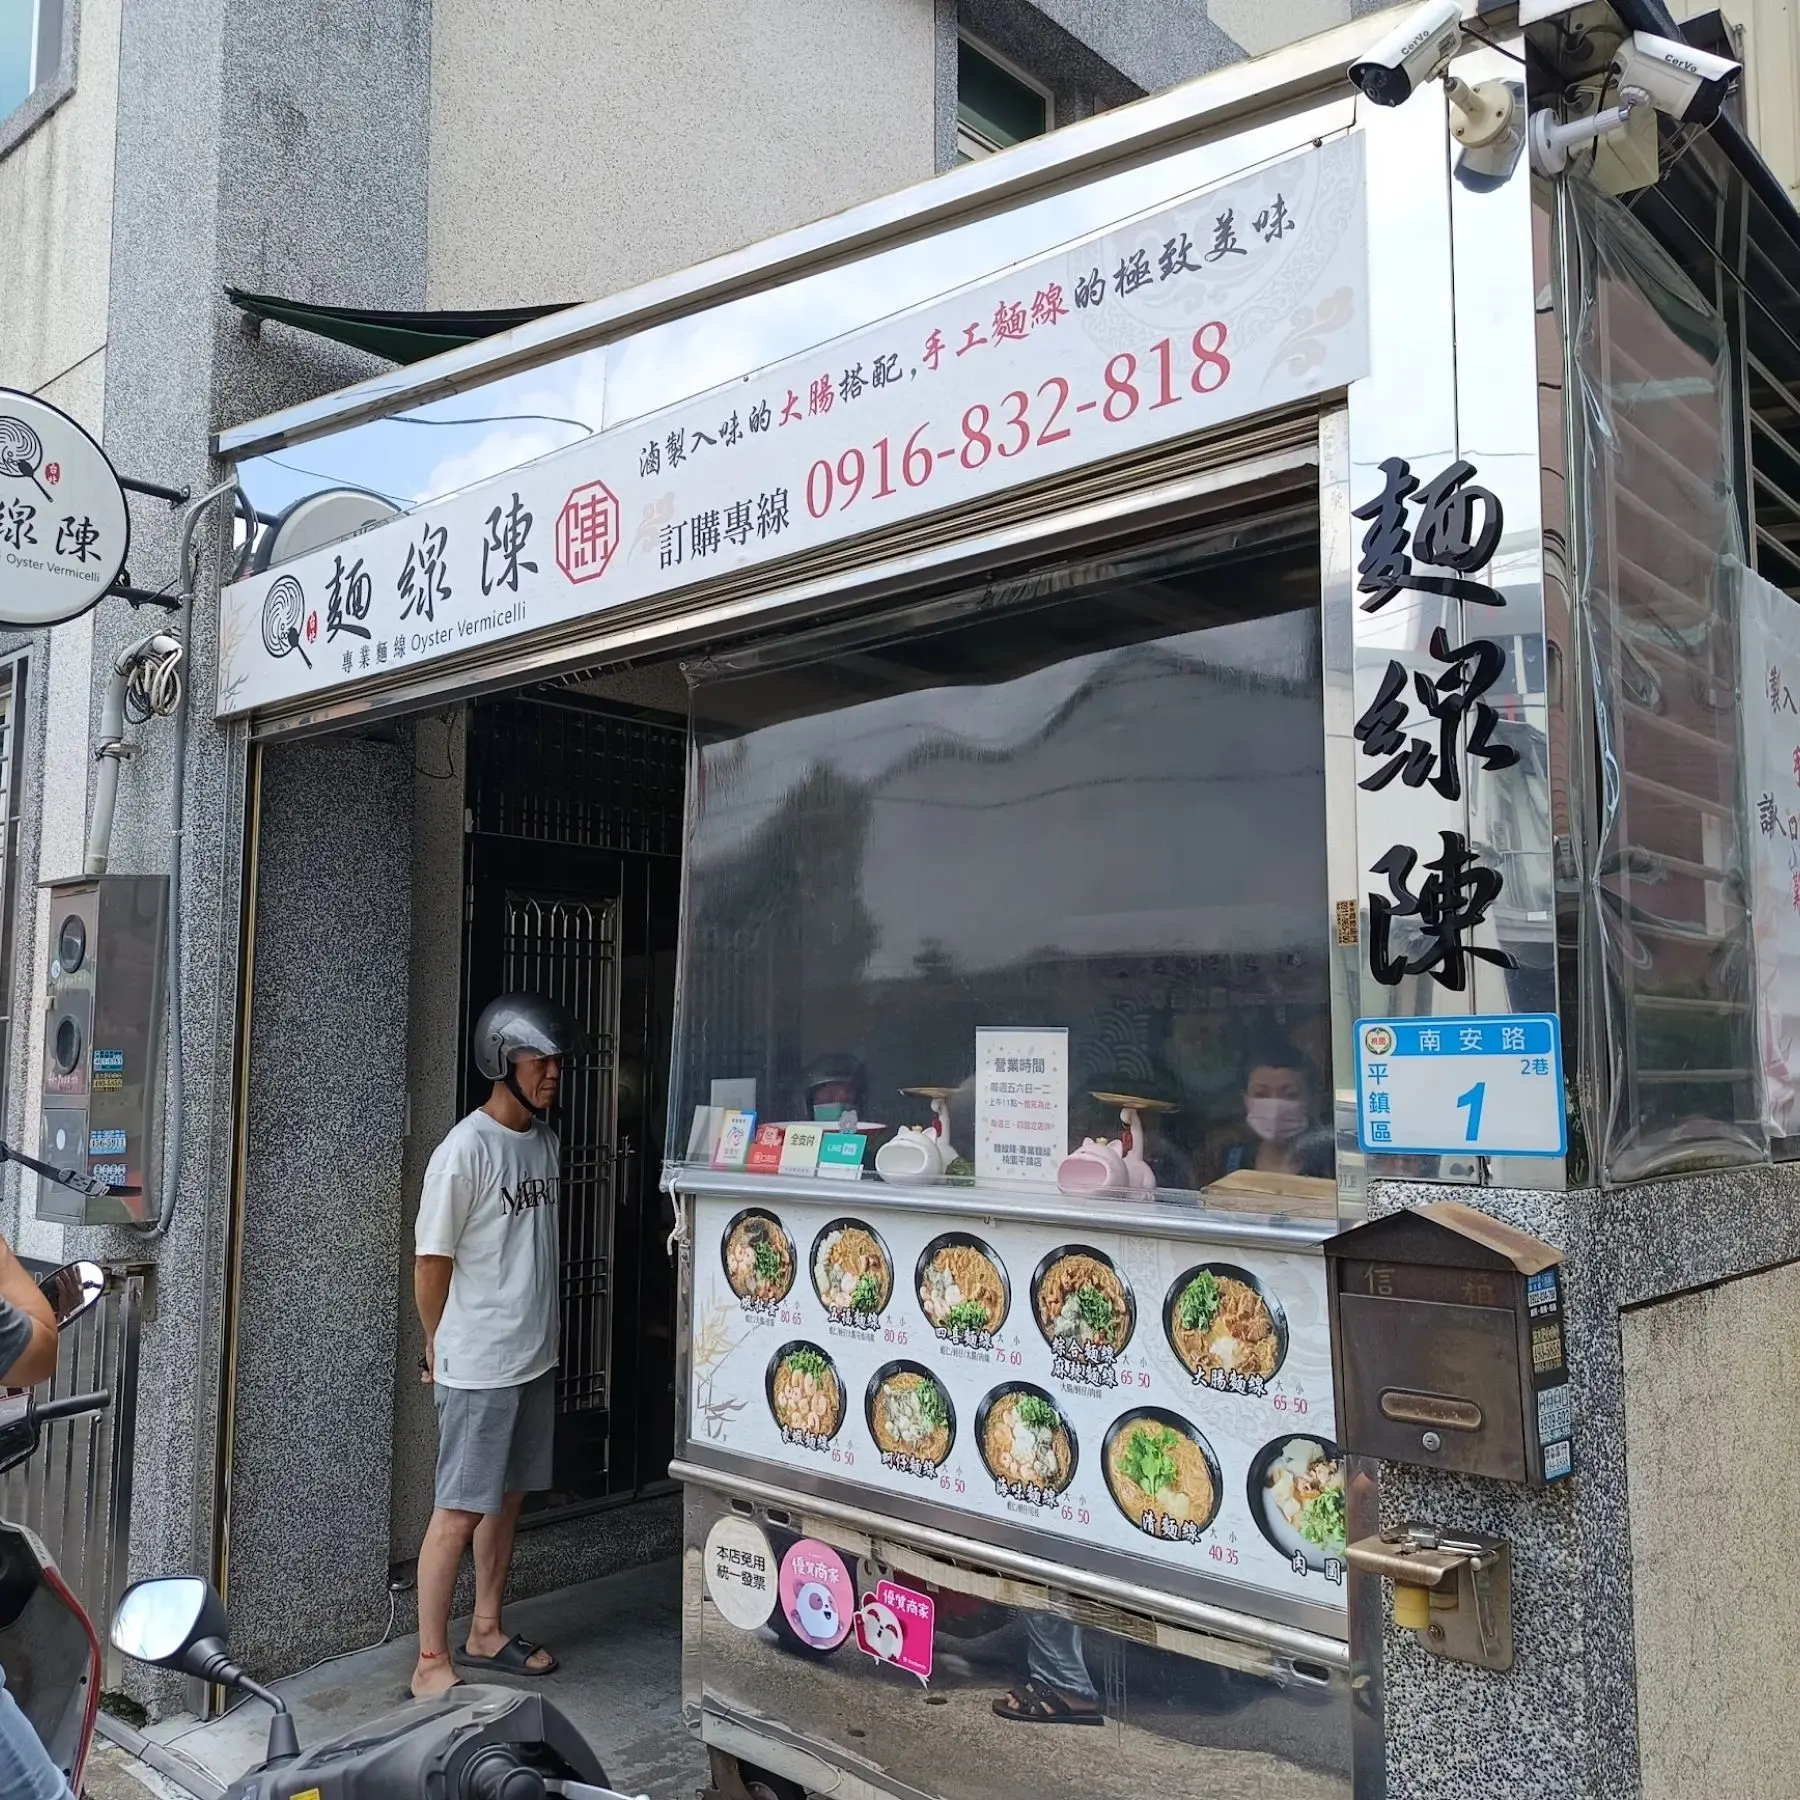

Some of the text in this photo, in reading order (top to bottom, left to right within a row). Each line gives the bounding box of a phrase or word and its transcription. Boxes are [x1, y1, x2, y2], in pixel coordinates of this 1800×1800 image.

[659, 321, 1231, 570] 訂購專線 0916-832-818
[6, 553, 101, 583] Oyster Vermicelli
[325, 492, 539, 645] 麵線陳
[340, 601, 527, 676] 專業麵線 Oyster Vermicelli
[1352, 456, 1521, 992] 麵線陳
[1418, 1026, 1526, 1052] 南安路
[994, 1057, 1045, 1074] 營業時間
[1520, 1058, 1549, 1076] 2巷
[1367, 1063, 1393, 1143] 平鎮區
[1456, 1081, 1486, 1142] 1
[790, 1133, 816, 1147] 全支付
[781, 1310, 802, 1325] 80 65
[884, 1329, 908, 1345] 80 65
[934, 1327, 994, 1351] 四喜麵線
[1051, 1335, 1117, 1364] 綜合麵線
[995, 1349, 1022, 1366] 75 60
[1051, 1357, 1118, 1388] 麻辣麵線
[1121, 1371, 1150, 1388] 65 50
[1192, 1366, 1269, 1396] 大腸麵線
[1273, 1395, 1308, 1414] 65 50
[832, 1450, 854, 1465] 65 50
[940, 1476, 965, 1493] 65 50
[1061, 1505, 1090, 1524] 65 50
[1141, 1509, 1201, 1545] 清麵線
[716, 1545, 765, 1572] 本店免用
[1208, 1544, 1239, 1566] 40 35
[1291, 1550, 1342, 1586] 肉圓
[716, 1563, 766, 1591] 統一發票
[792, 1556, 841, 1583] 優質商家
[883, 1588, 929, 1619] 優質商家
